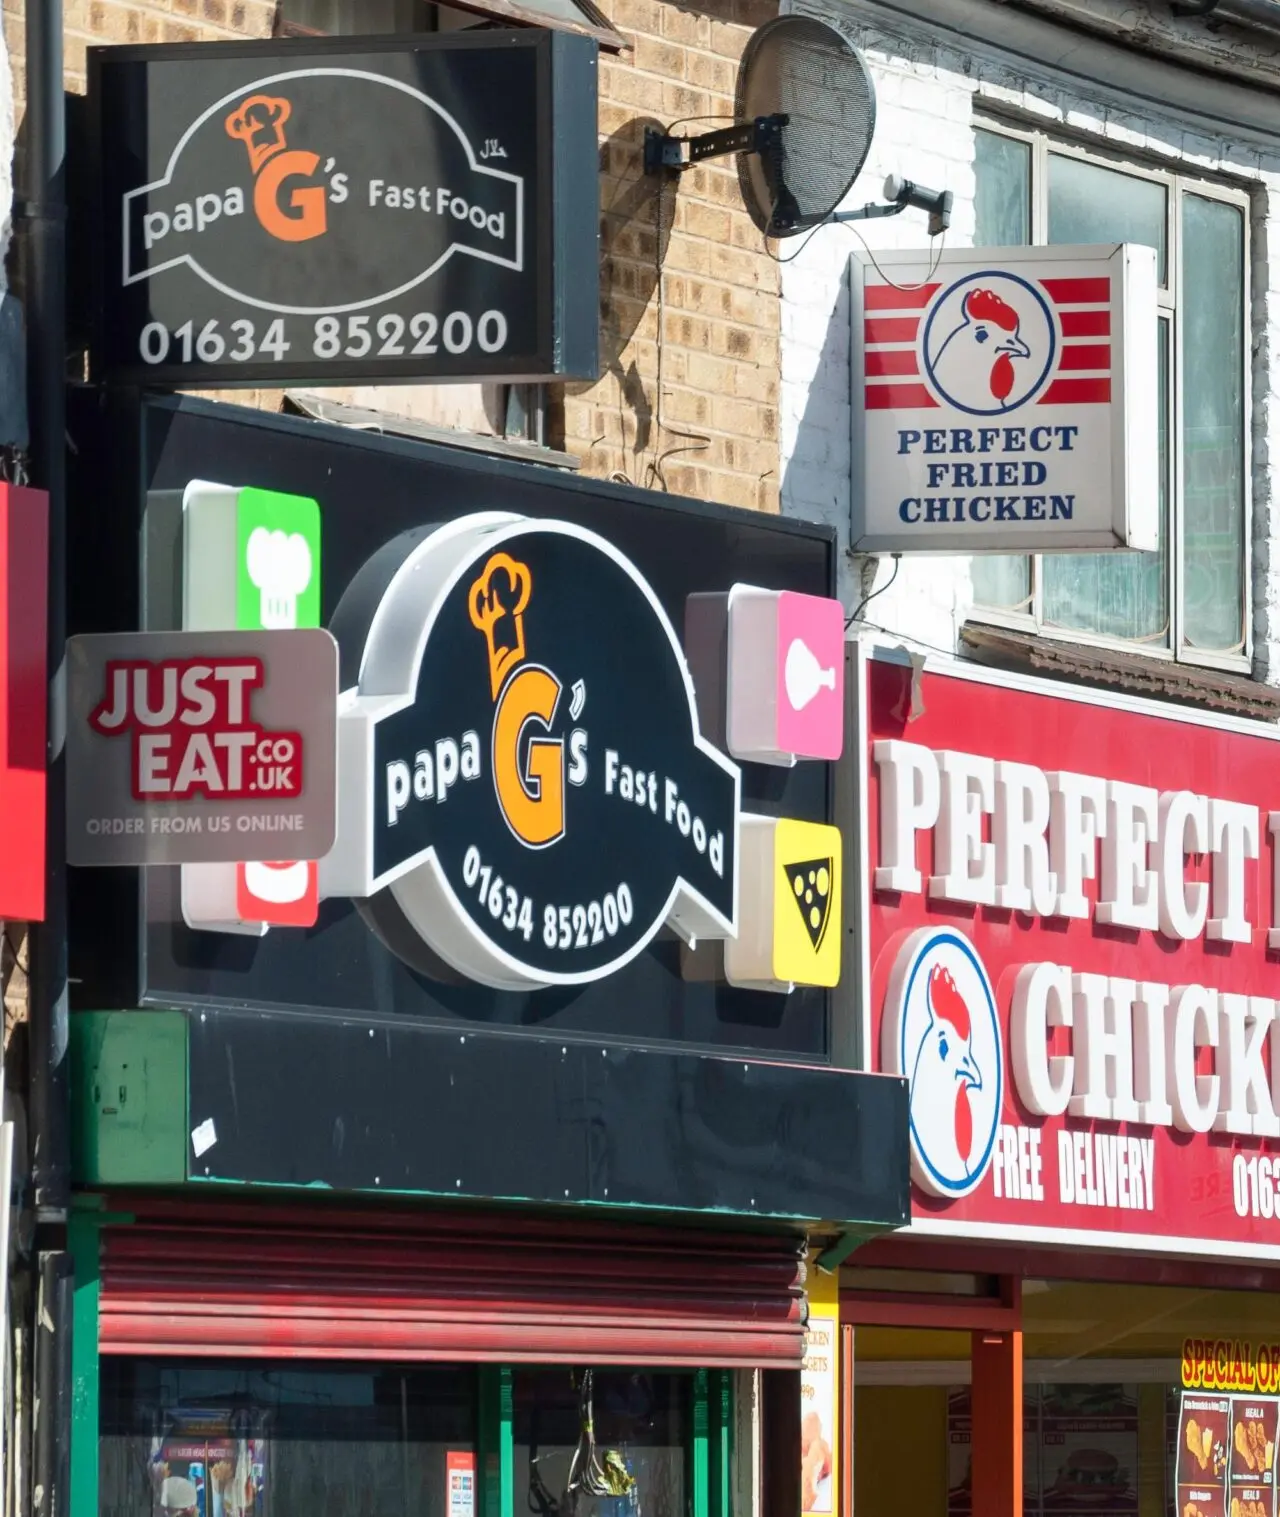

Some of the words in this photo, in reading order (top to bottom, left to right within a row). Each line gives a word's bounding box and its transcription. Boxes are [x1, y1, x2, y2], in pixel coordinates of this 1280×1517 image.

[144, 186, 244, 249] papa
[368, 179, 431, 213] Fast
[437, 188, 506, 239] Food
[139, 318, 291, 364] 01634
[312, 310, 508, 359] 852200
[897, 426, 1078, 455] PERFECT
[927, 461, 1047, 488] FRIED
[899, 495, 1075, 523] CHICKEN
[97, 665, 256, 728] JUST
[139, 732, 255, 793] EAT
[86, 817, 145, 835] ORDER
[151, 816, 202, 834] FROM
[207, 816, 231, 832] US
[236, 814, 304, 832] ONLINE
[386, 731, 480, 826] papa
[605, 750, 656, 810] Fast
[665, 778, 724, 878] Food
[874, 739, 1259, 945] PERFECT
[463, 845, 533, 941] 01634
[543, 882, 633, 949] 852200
[993, 1123, 1043, 1202] FREE
[1058, 1130, 1155, 1212] DELIVERY
[1181, 1338, 1255, 1388] SPECIAL
